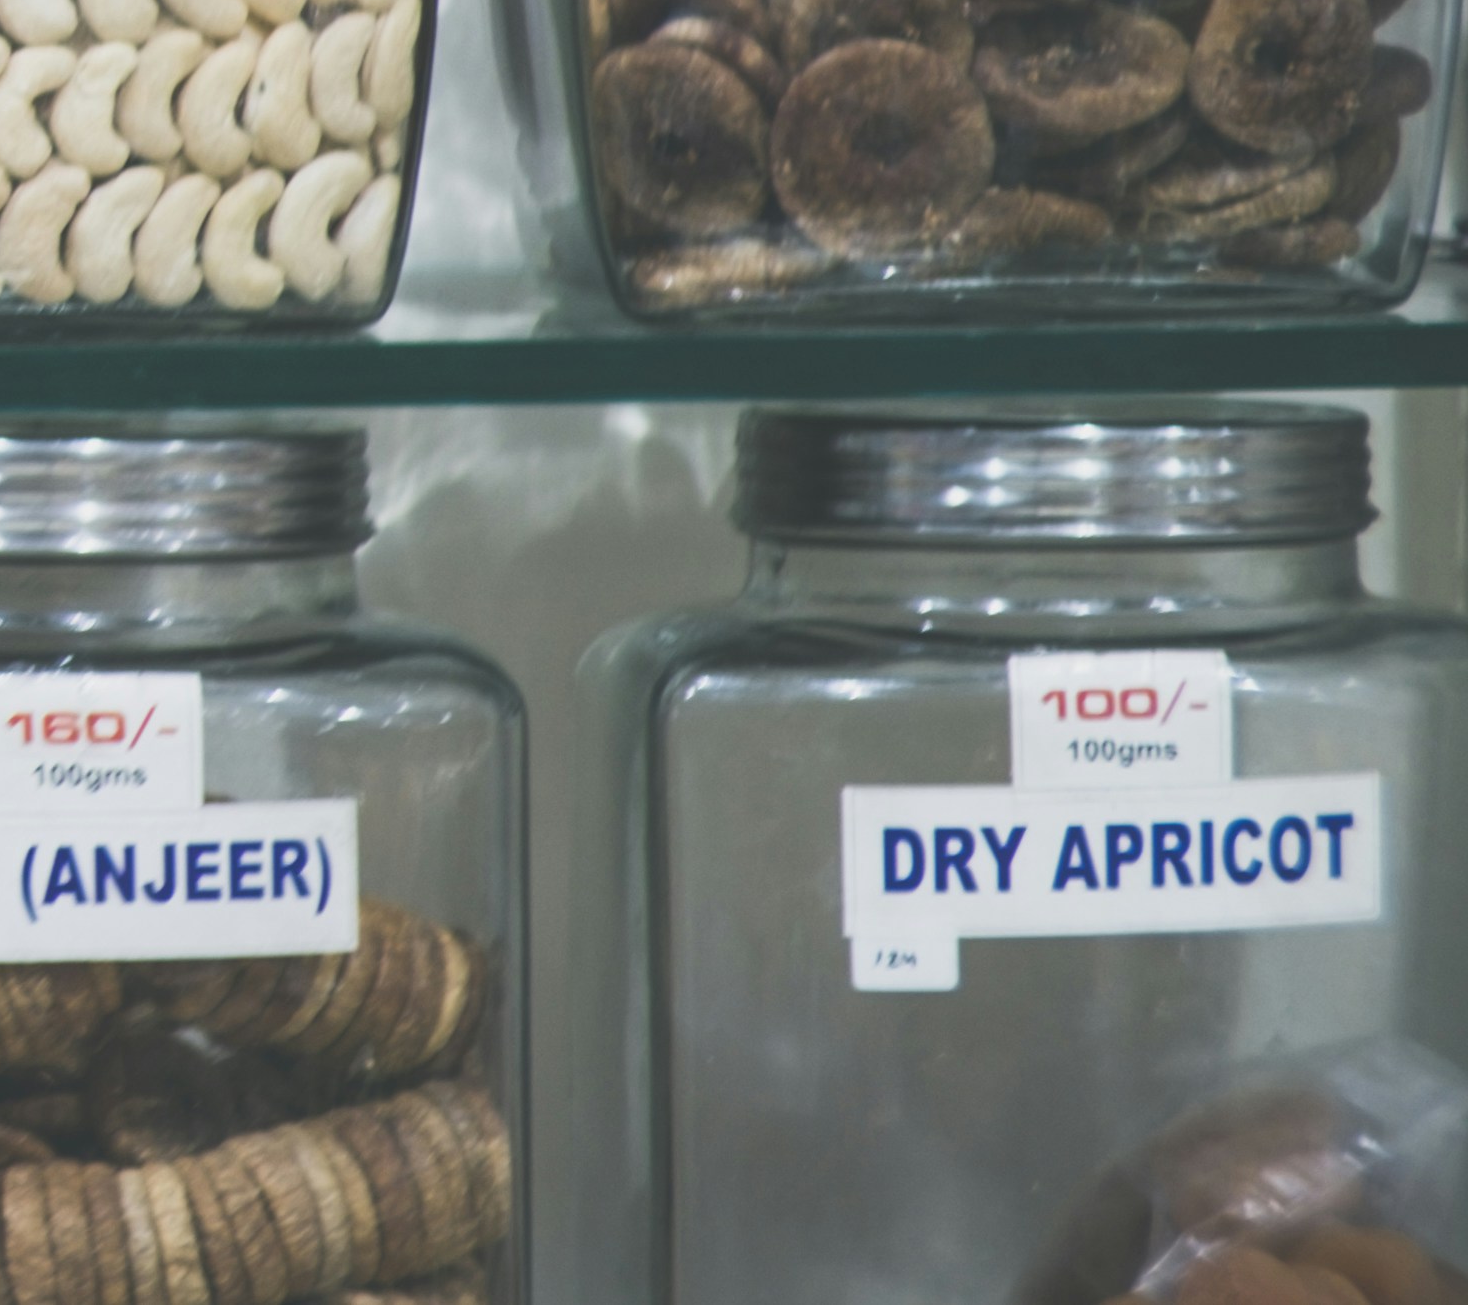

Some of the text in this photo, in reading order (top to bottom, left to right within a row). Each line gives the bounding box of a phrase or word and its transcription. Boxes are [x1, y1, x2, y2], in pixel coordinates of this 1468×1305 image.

[1040, 683, 1210, 724] 100/-
[1067, 739, 1179, 768] 100gms
[33, 763, 147, 794] 100gms
[882, 812, 1355, 894] DRY APRICOT
[20, 837, 332, 922] (ANJEER)
